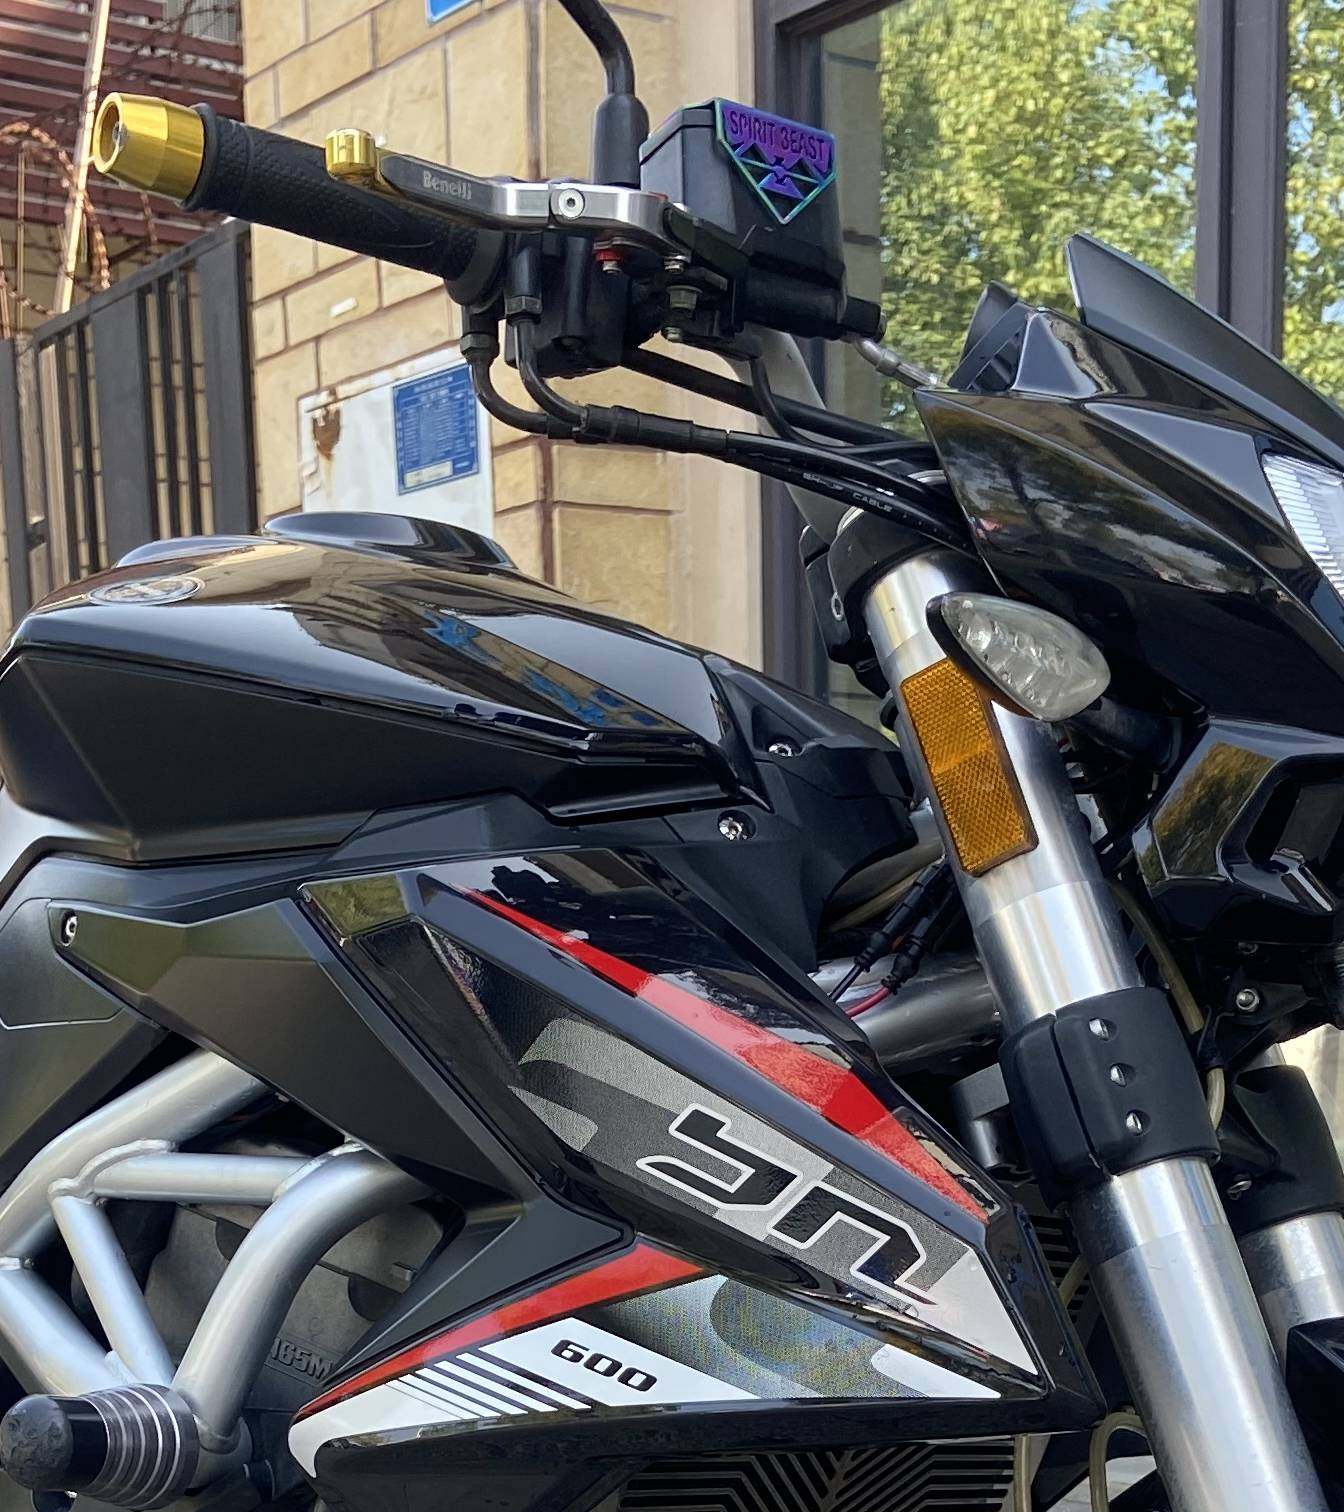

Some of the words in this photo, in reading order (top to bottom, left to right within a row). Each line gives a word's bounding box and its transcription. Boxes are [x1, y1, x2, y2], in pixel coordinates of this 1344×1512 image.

[729, 110, 776, 146] SPIRIT
[423, 170, 472, 200] Benelli
[548, 1337, 659, 1394] 600
